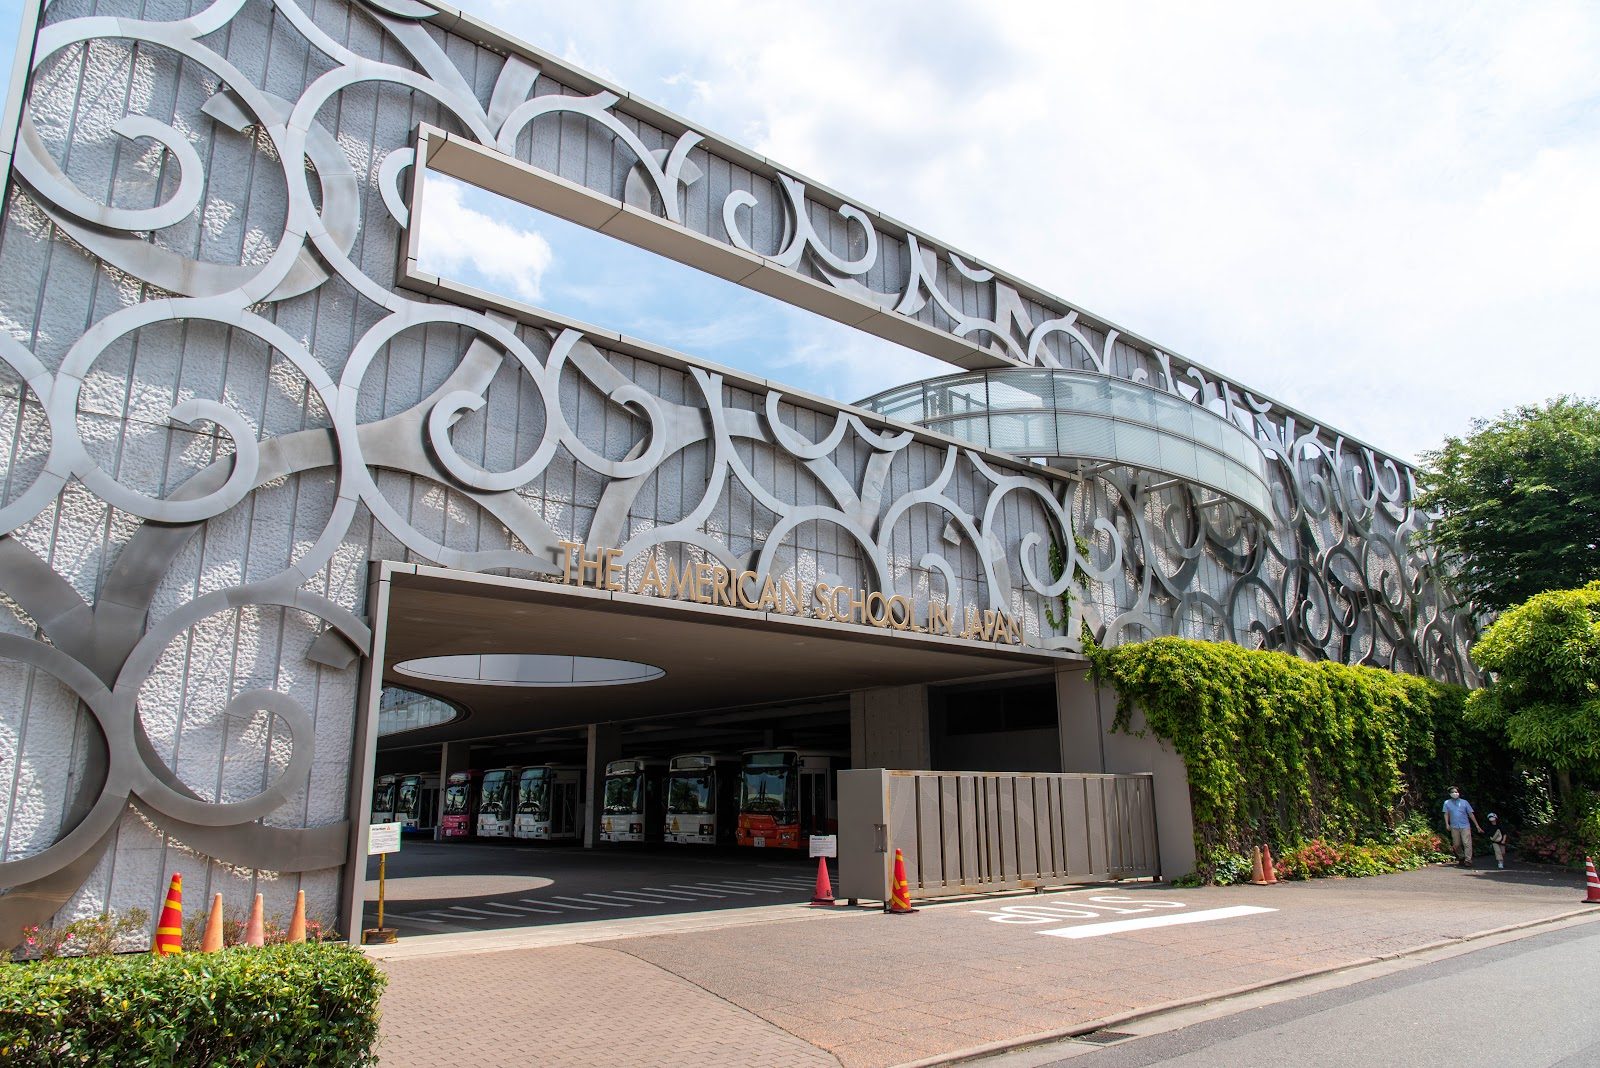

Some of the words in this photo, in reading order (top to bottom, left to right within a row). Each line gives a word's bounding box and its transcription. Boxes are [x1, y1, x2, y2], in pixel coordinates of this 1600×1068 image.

[558, 540, 624, 590] THE
[637, 553, 802, 616] AMERICAN
[815, 582, 921, 632] SCHOOL
[927, 600, 954, 636] IN
[960, 606, 1024, 645] JAPAN
[968, 896, 1186, 924] STOP
